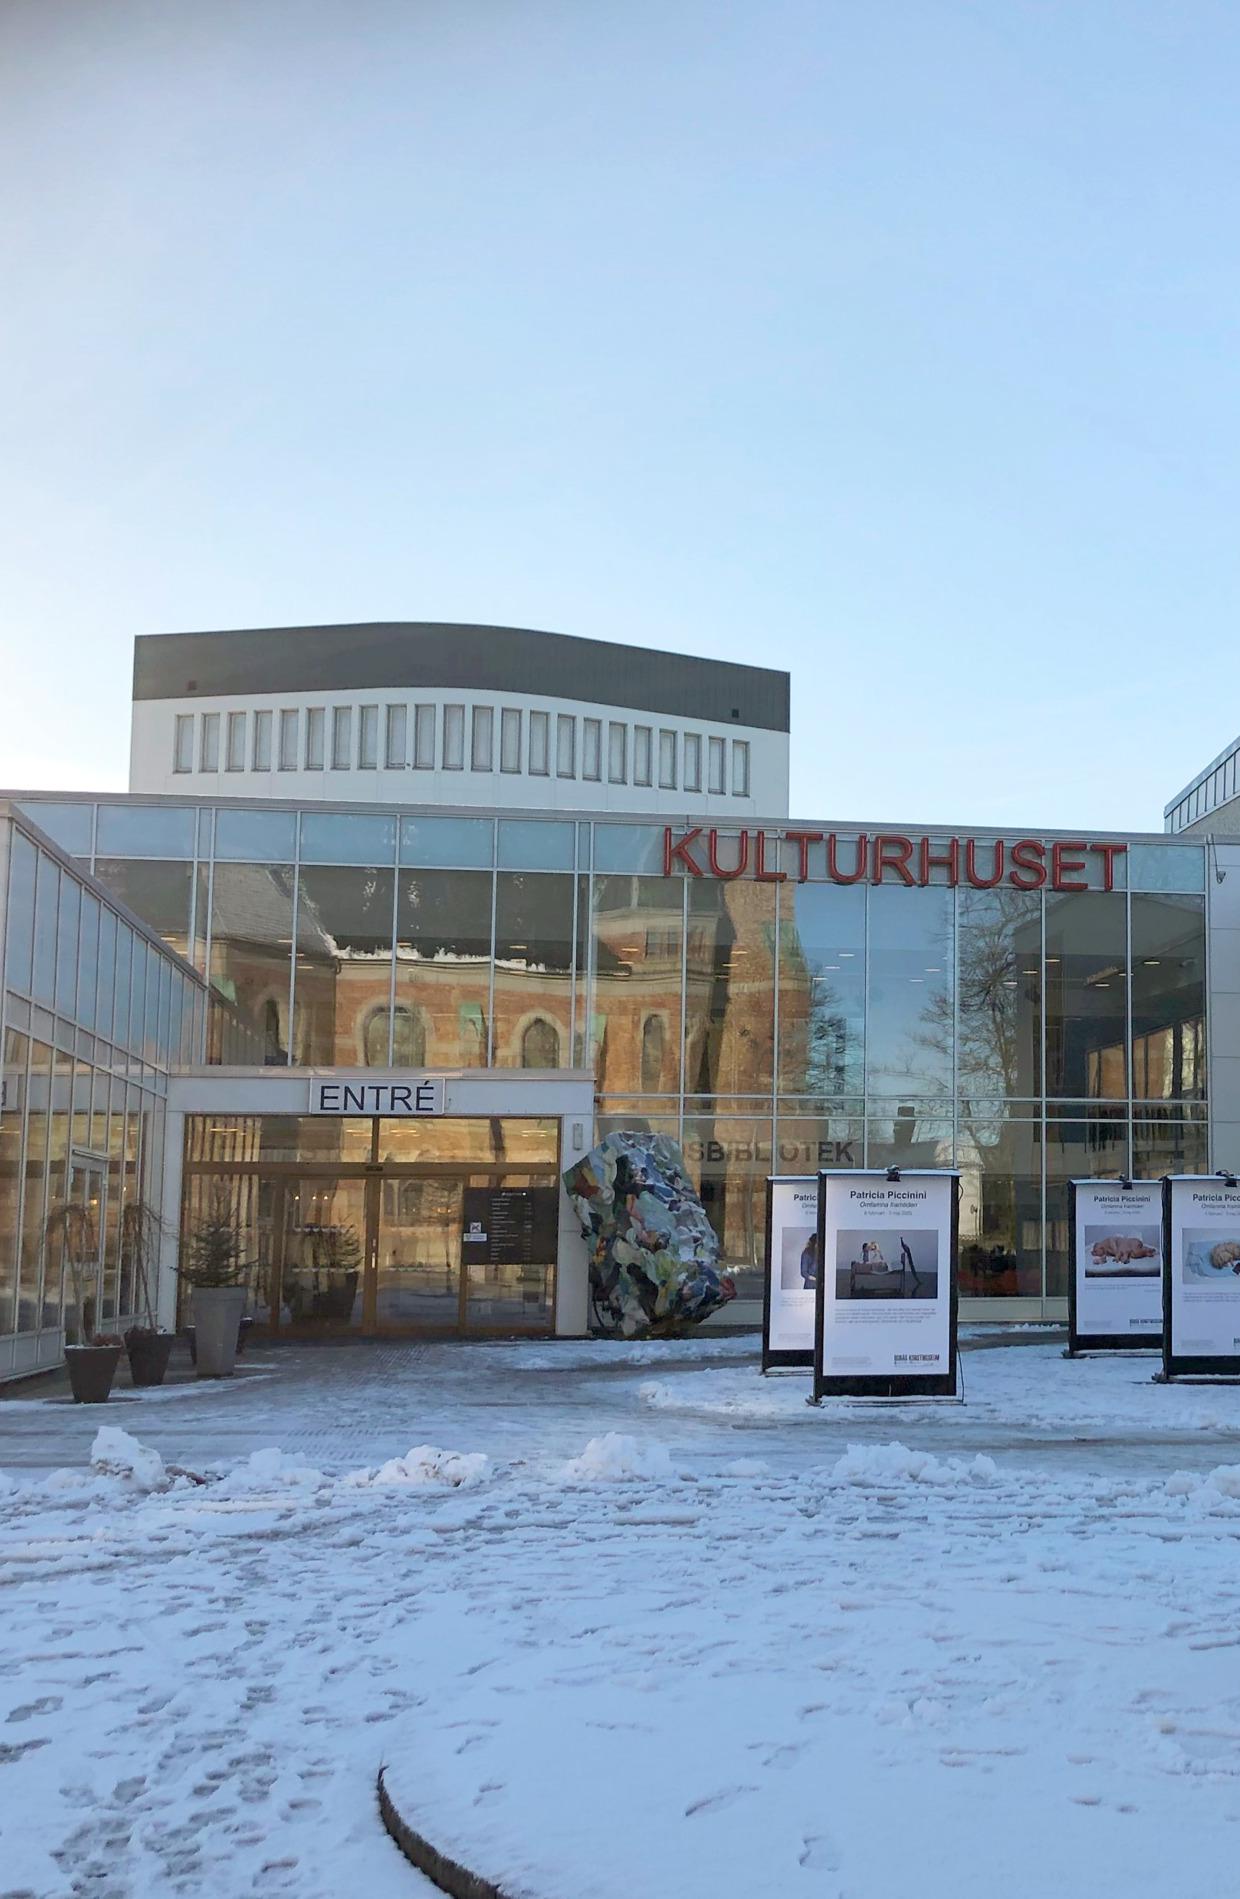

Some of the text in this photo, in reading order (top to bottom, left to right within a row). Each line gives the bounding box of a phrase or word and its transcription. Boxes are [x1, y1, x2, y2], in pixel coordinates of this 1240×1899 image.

[663, 827, 1128, 892] KULTURHUSET
[320, 1080, 434, 1111] ENTRÉ
[850, 1190, 927, 1200] Patricia Piccinini
[1192, 1193, 1223, 1202] Patricia
